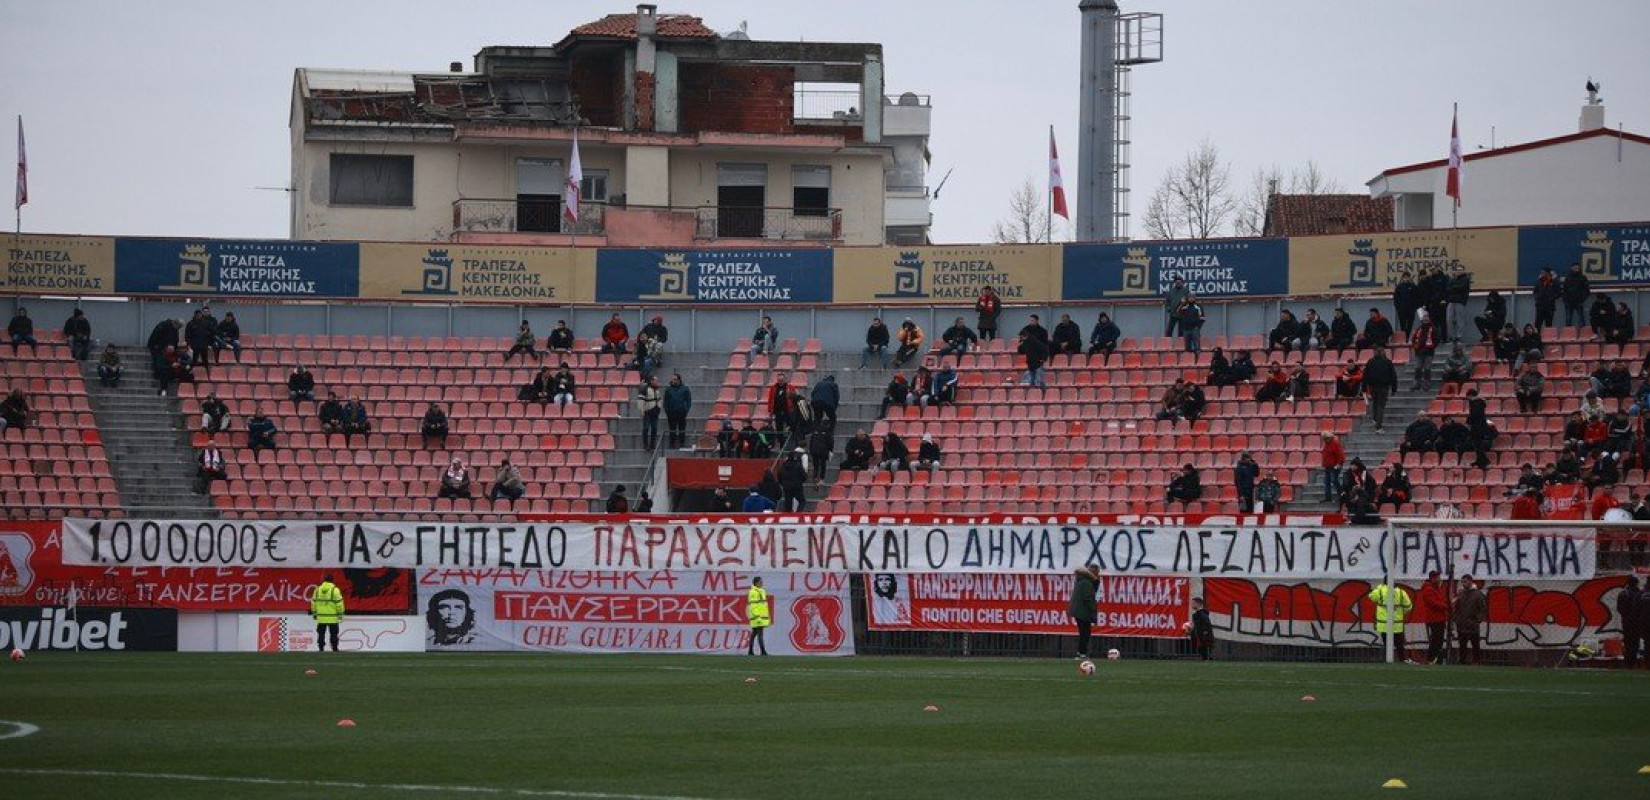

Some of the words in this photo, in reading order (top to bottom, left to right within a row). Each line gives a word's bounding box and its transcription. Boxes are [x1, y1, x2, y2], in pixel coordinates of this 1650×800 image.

[1620, 239, 1650, 252] ΤΡΑ
[8, 249, 71, 262] ΤΡΑΠΕΖΑ
[1386, 246, 1449, 259] ΤΡΑΠΕΖΑ
[219, 255, 286, 267] ΤΡΑΠΕΖΑ
[462, 260, 526, 272] ΤΡΑΠΕΖΑ
[933, 261, 995, 272] ΤΡΑΠΕΖΑ
[1159, 255, 1220, 268] ΤΡΑΠΕΖΑ
[8, 262, 86, 276] ΚΕΝΤΡΙΚΗΣ
[220, 267, 301, 280] ΚΕΝΤΡΙΚΗΣ
[698, 262, 762, 274] ΤΡΑΠΕΖΑ
[1160, 267, 1234, 281] ΚΕΝΤΡΙΚΗΣ
[8, 275, 102, 289] ΜΑΚΕΔΟΝΙΑΣ
[462, 272, 541, 285] ΚΕΝΤΡΙΚΗΣ
[698, 275, 776, 287] ΚΕΝΤΡΙΚΗΣ
[933, 273, 1009, 285] ΚΕΝΤΡΙΚΗΣ
[220, 281, 315, 293] ΜΑΚΕΔΟΝΙΑΣ
[462, 285, 555, 298] ΜΑΚΕΔΟΝΙΑΣ
[933, 286, 1024, 298] ΜΑΚΕΔΝΙΑΣ
[1160, 281, 1248, 295] ΜΕΔΟΝΙΑΣ
[698, 288, 791, 300] ΜΑΚΕΔΟΝΙΑΣ
[89, 521, 287, 564] 1.000.000€
[315, 523, 371, 564] ΓΙΑ
[416, 525, 566, 568] ΓΗΠΕΔΟ
[593, 524, 848, 569] ΠΑΡΑΧΩΜΕΝΑ
[858, 528, 909, 571] ΚΑΙ
[925, 527, 949, 570] Ο
[961, 527, 1157, 572] ΔΗΜΑΡΧΟΣ
[1173, 529, 1345, 573] ΛΕΖΑΝΤΑ
[135, 580, 318, 602] ΠΑΝΣΕΡΡΑΪΚΟ
[1025, 574, 1044, 601] ΝΑ
[501, 593, 750, 622] ΠΑΝΣΕΡΡΑΪΚ
[921, 607, 974, 623] ΠΟΝΤΙΟΙ
[976, 608, 1004, 624] CHE
[1005, 609, 1069, 625] GUEVARA
[1108, 611, 1176, 630] SALONICA
[522, 625, 569, 647] CHE
[581, 625, 683, 650] GUEVARA
[695, 627, 751, 650] CLUB
